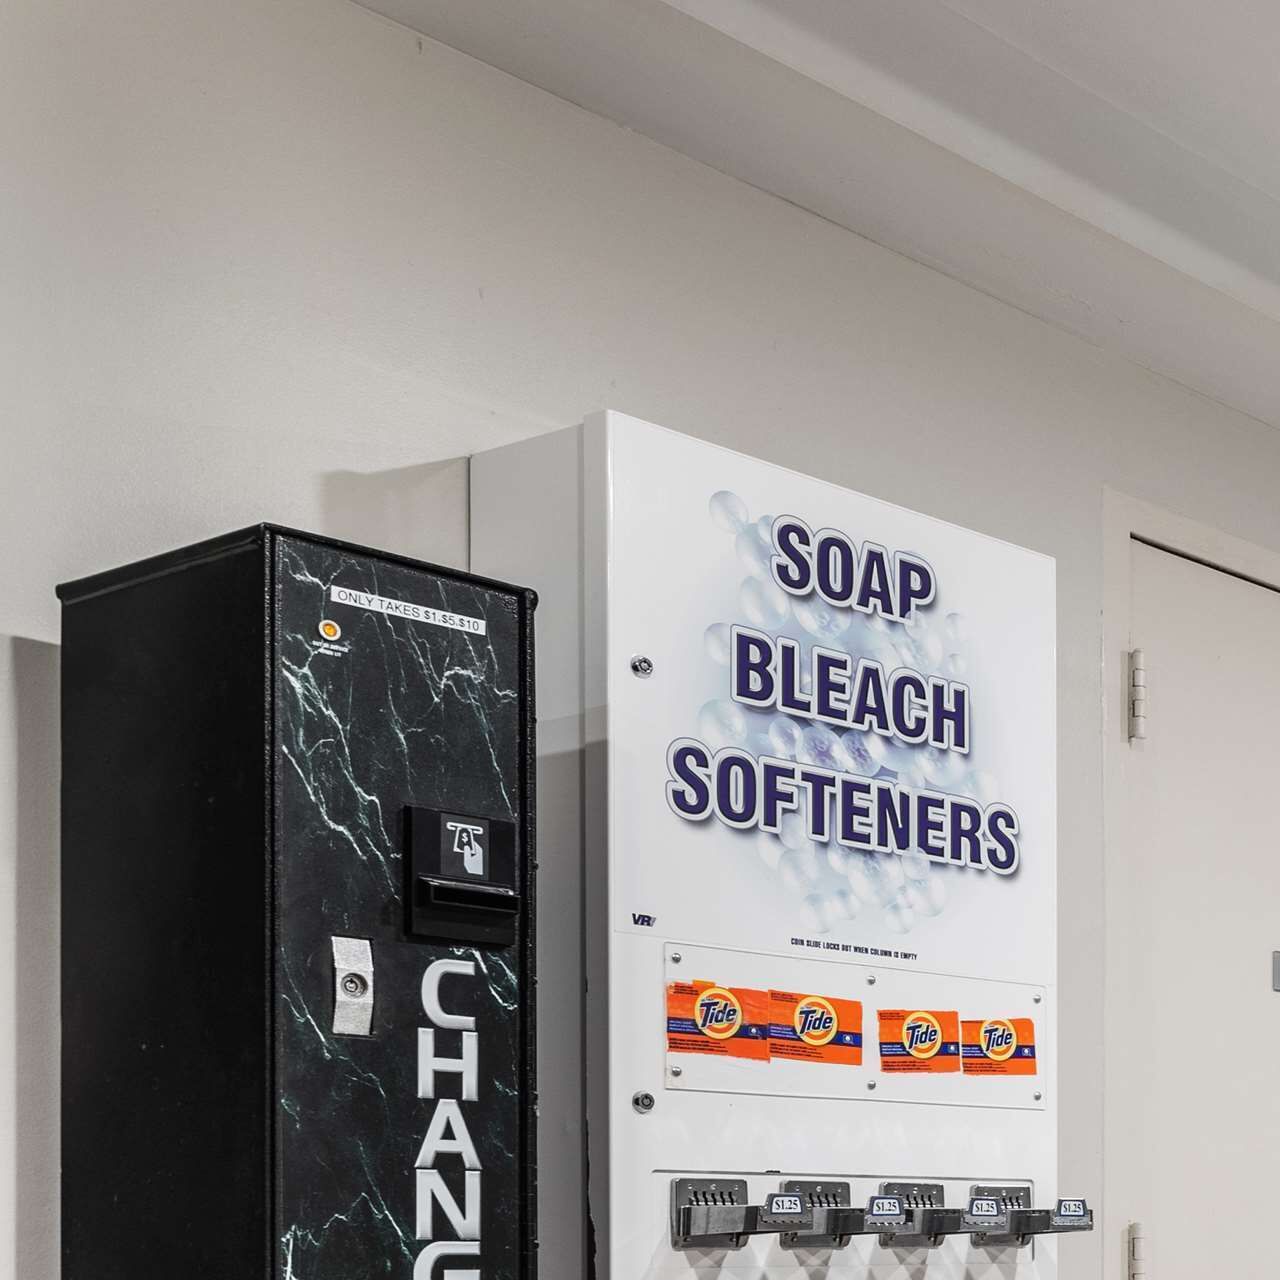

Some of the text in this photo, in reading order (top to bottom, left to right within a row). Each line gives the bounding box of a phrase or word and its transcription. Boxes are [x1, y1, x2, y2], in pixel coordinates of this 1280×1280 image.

[774, 520, 934, 620] SOAP
[337, 589, 375, 608] ONLY
[378, 598, 421, 619] TAKES
[734, 629, 969, 750] BLEACH
[668, 742, 1019, 872] SOFTENERS
[791, 938, 805, 946] COIN
[806, 940, 822, 949] SLIDE
[823, 941, 840, 951] LOCKS
[853, 946, 869, 954] WHEN
[870, 947, 893, 958] COLUMN
[900, 952, 918, 960] EMPTY
[700, 1001, 738, 1028] Tide
[799, 1009, 833, 1035] Tide
[906, 1023, 938, 1050] Tide
[983, 1026, 1013, 1052] Tide
[774, 1199, 799, 1210] $1.25
[875, 1201, 897, 1212] $1.25
[974, 1202, 995, 1213] $1.25
[1063, 1202, 1082, 1213] $1.25
